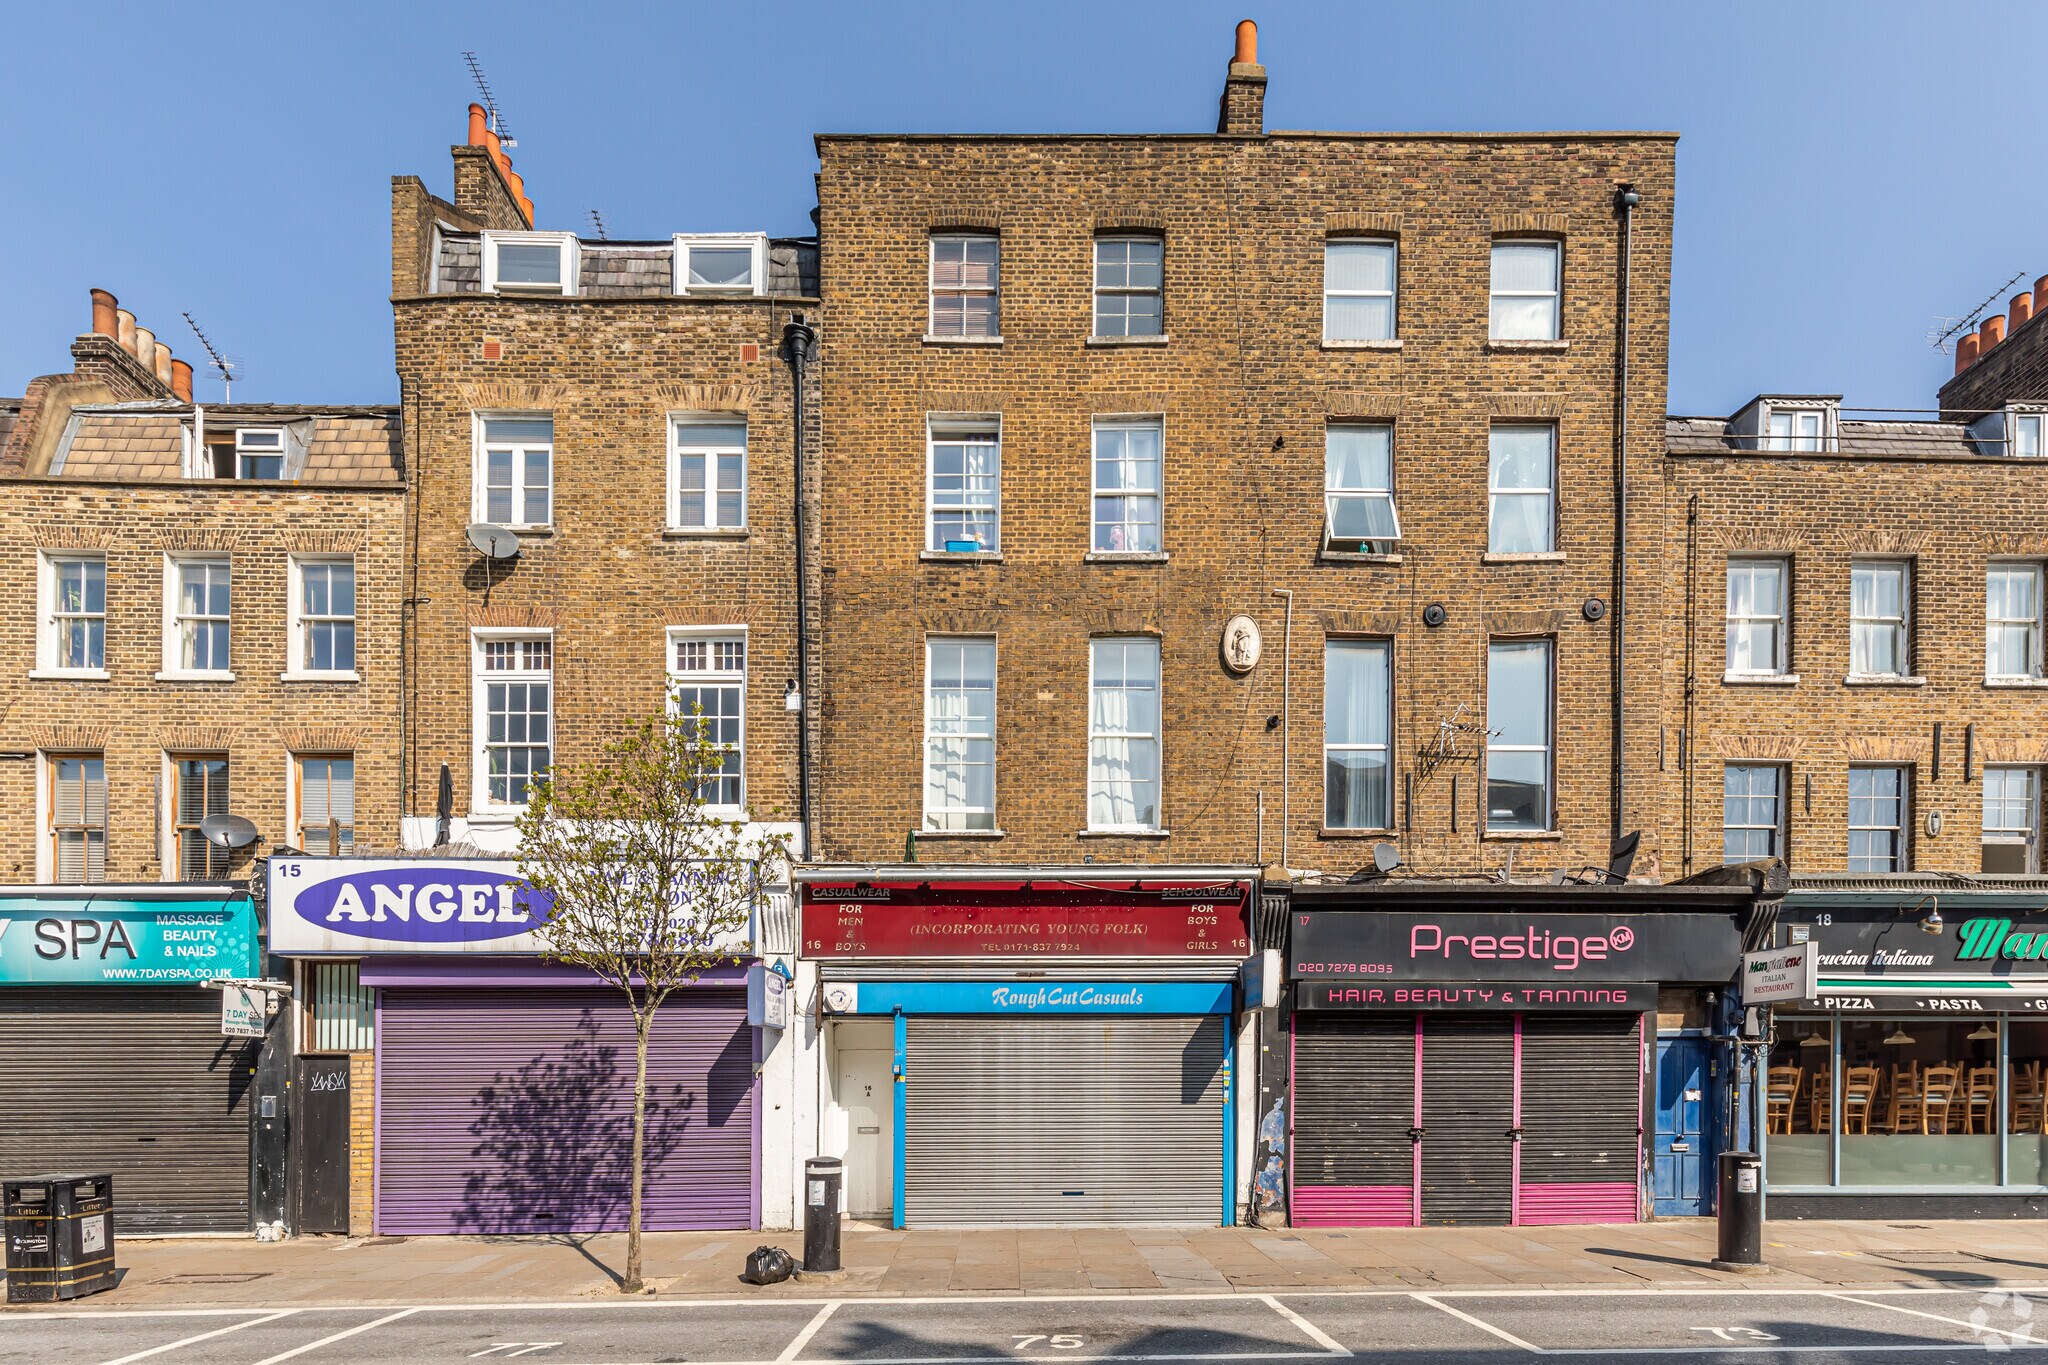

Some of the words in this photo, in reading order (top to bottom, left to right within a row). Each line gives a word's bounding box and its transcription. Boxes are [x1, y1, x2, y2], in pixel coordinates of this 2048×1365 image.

[278, 864, 301, 878] 15
[812, 887, 890, 897] CASUALWEAR
[1161, 887, 1241, 897] SCHOOLWEAR
[325, 882, 529, 923] ANGEL
[839, 904, 862, 914] FOR
[1191, 904, 1214, 913] FOR
[156, 914, 224, 926] MASSAGE
[668, 917, 696, 929] 020
[838, 917, 863, 926] MEN
[1187, 916, 1217, 925] BOYS
[1300, 915, 1310, 926] 17
[1815, 913, 1832, 926] 18
[846, 930, 854, 938] &
[910, 923, 1040, 936] (INCORPORATING
[1048, 923, 1100, 935] YOUNG
[1103, 923, 1149, 935] FOLK)
[1198, 929, 1206, 938] &
[34, 918, 138, 960] SPA
[163, 930, 218, 942] BEAUTY
[1612, 931, 1632, 946] KM
[806, 940, 821, 950] 16
[835, 942, 866, 951] BOYS
[981, 943, 1001, 951] TEL
[1003, 943, 1051, 951] 0171-837
[1054, 943, 1080, 951] 7924
[1186, 941, 1218, 950] GIRLS
[1231, 939, 1246, 948] 16
[1410, 925, 1608, 970] Prestige
[164, 945, 174, 957] &
[177, 945, 217, 957] NAILS
[1817, 949, 1869, 966] cucina
[1871, 948, 1934, 966] italiana
[103, 968, 232, 979] WWW.7DAYSPA.CO.UK
[1297, 963, 1324, 973] 020
[1327, 963, 1357, 973] 7278
[1360, 963, 1393, 974] 8095
[1761, 973, 1787, 983] ITALIAN
[1753, 982, 1794, 994] RESTAURANT
[1328, 989, 1387, 1004] HAIR,
[1395, 989, 1494, 1002] BEAUTY
[1501, 991, 1514, 1003] &
[1522, 989, 1627, 1003] TANNING
[1824, 997, 1875, 1009] PIZZA
[1928, 999, 1983, 1010] PASTA
[226, 1009, 231, 1017] 7
[232, 1009, 248, 1018] DAY
[82, 1203, 100, 1212] Litter
[1689, 1327, 1781, 1341] 73
[1011, 1334, 1084, 1350] 75
[465, 1341, 563, 1358] 77
